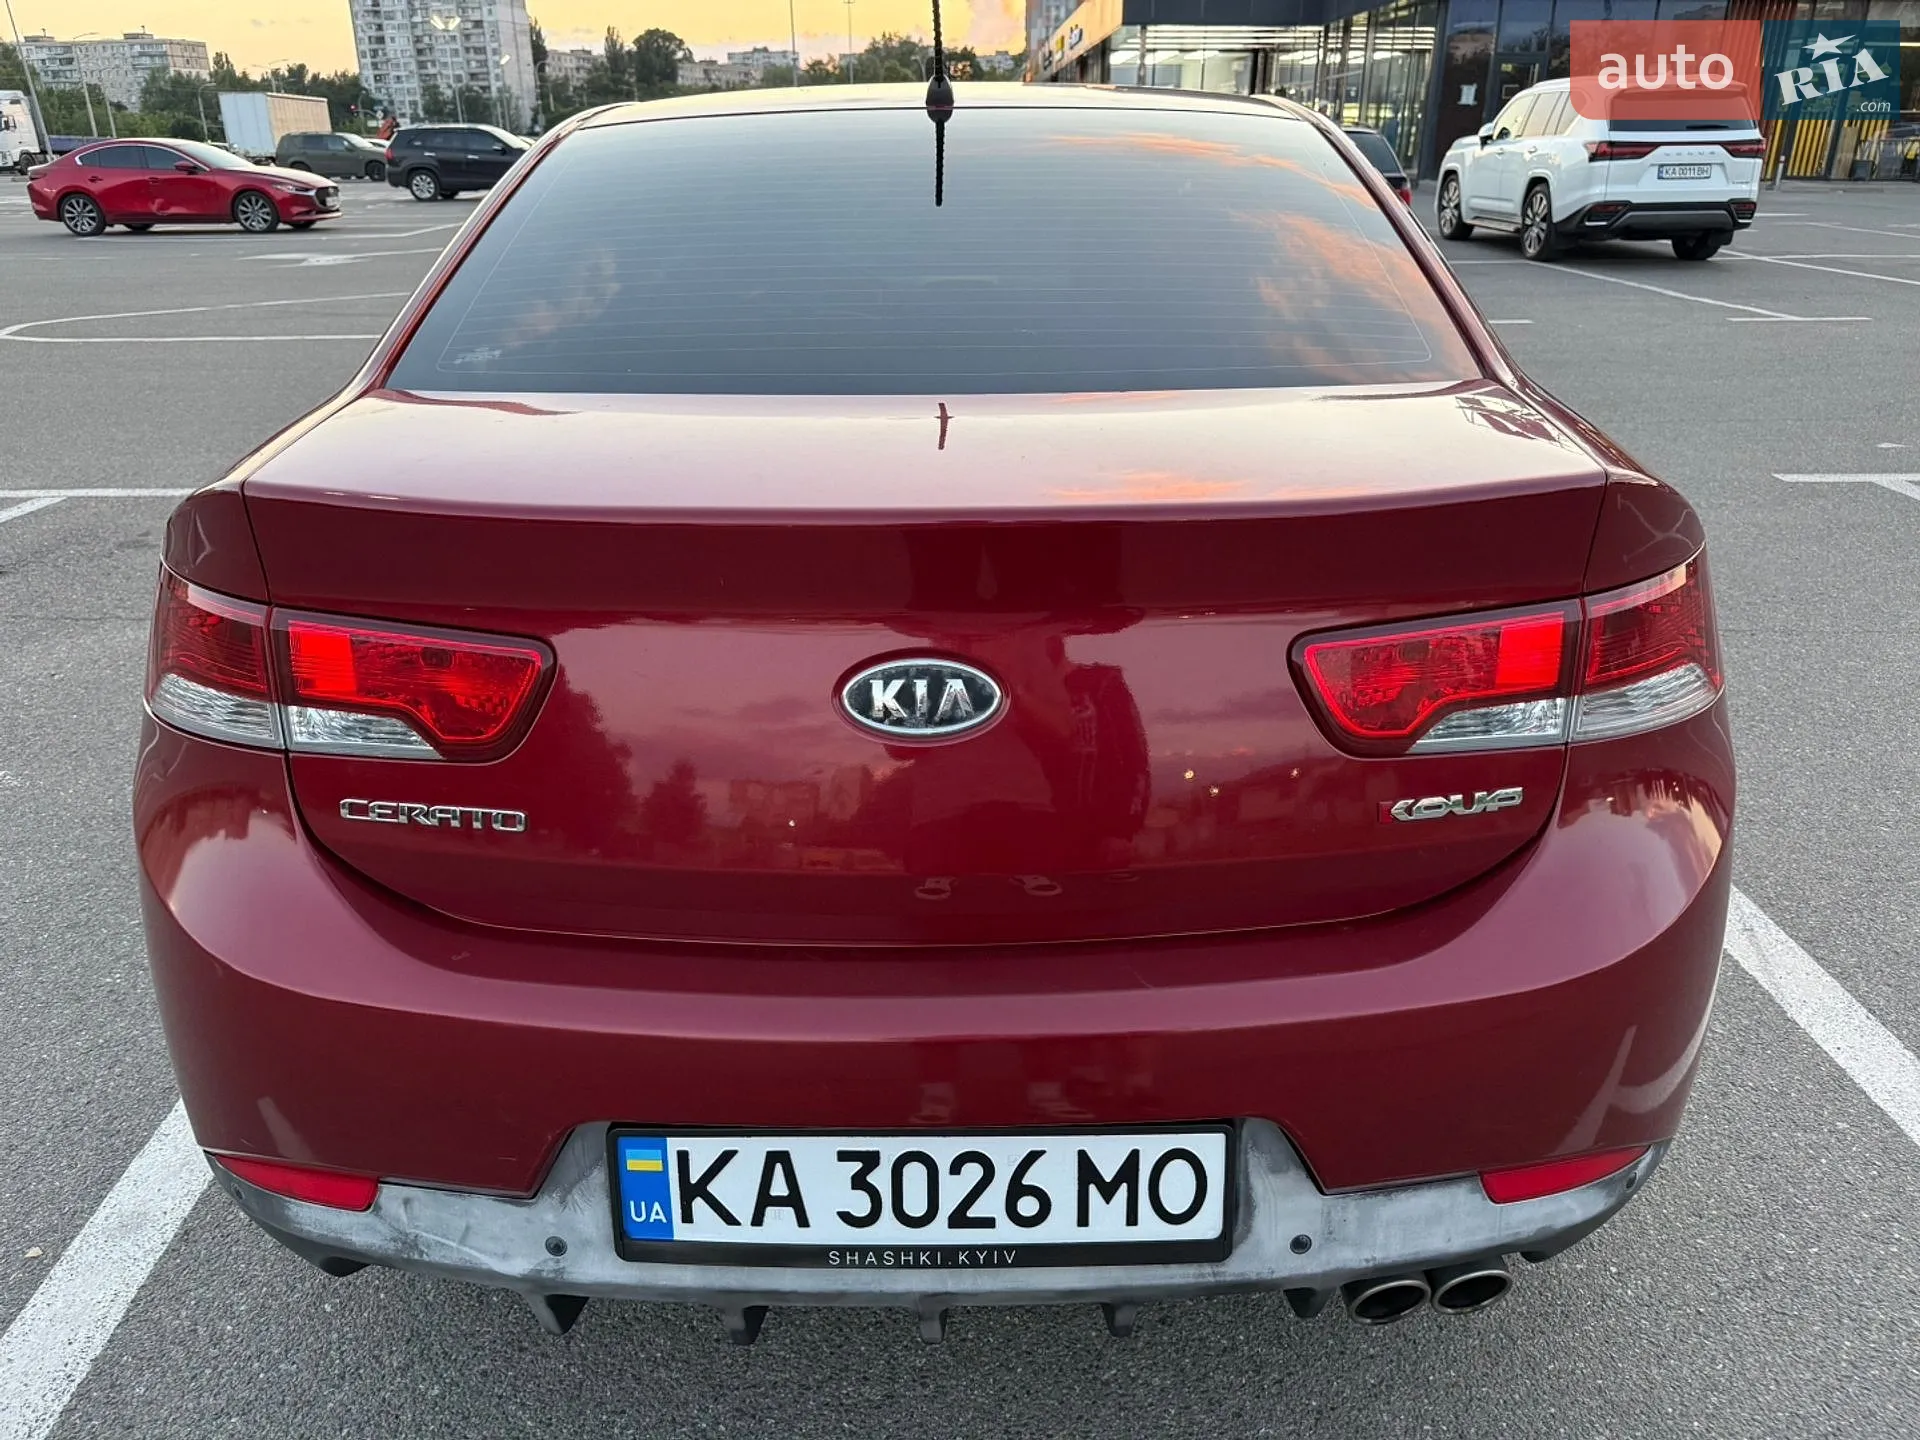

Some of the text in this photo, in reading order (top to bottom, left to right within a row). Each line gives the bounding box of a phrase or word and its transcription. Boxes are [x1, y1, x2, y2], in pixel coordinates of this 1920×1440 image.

[1664, 167, 1677, 177] KA
[869, 678, 975, 721] KIA
[339, 798, 526, 832] CERATO
[1379, 786, 1523, 823] KOUP
[676, 1147, 1208, 1229] KA 3026 MO
[629, 1200, 667, 1224] UA
[827, 1249, 1017, 1266] SHASHKI.KYIV
